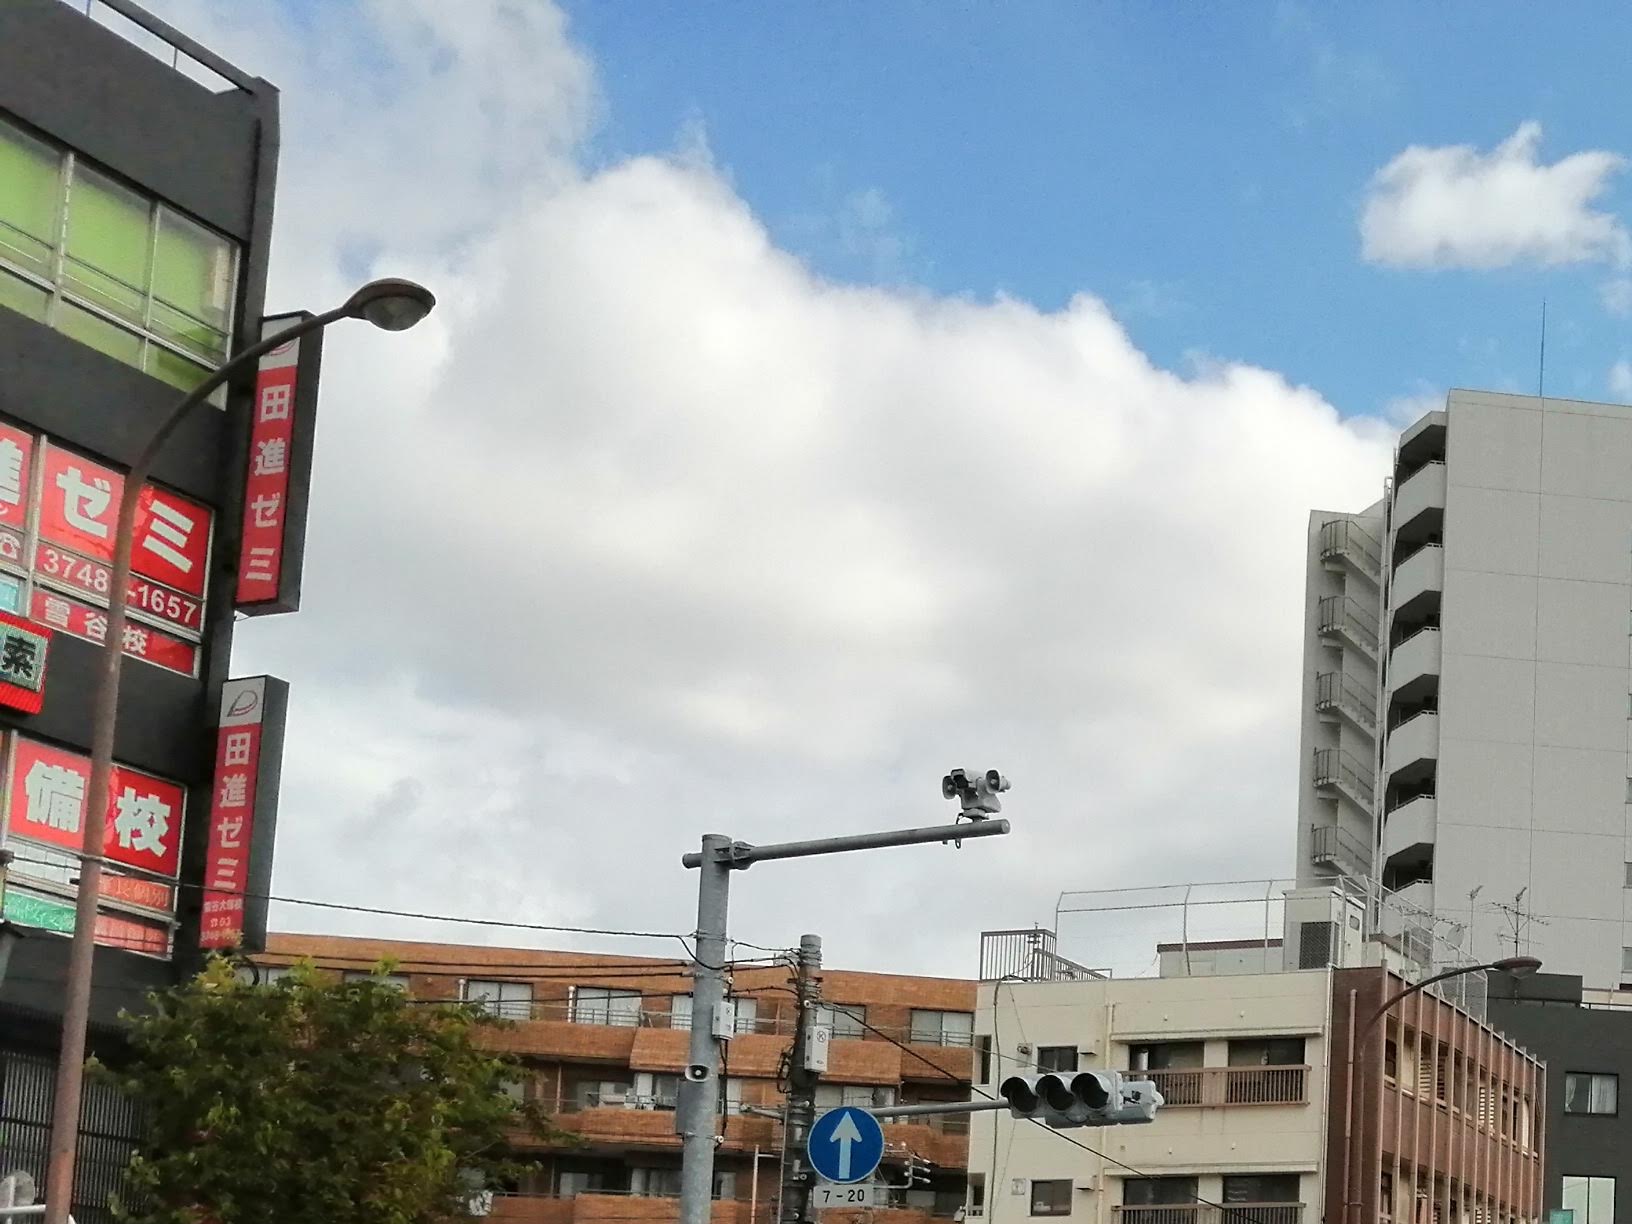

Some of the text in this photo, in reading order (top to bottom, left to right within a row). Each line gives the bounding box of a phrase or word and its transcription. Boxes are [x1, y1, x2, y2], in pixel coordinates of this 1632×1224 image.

[245, 384, 290, 581] 田進ゼミ
[43, 549, 197, 623] 3748-1657
[44, 597, 147, 656] 雪谷校
[213, 732, 251, 890] 田進ゼミ
[823, 1189, 865, 1203] 7-20
